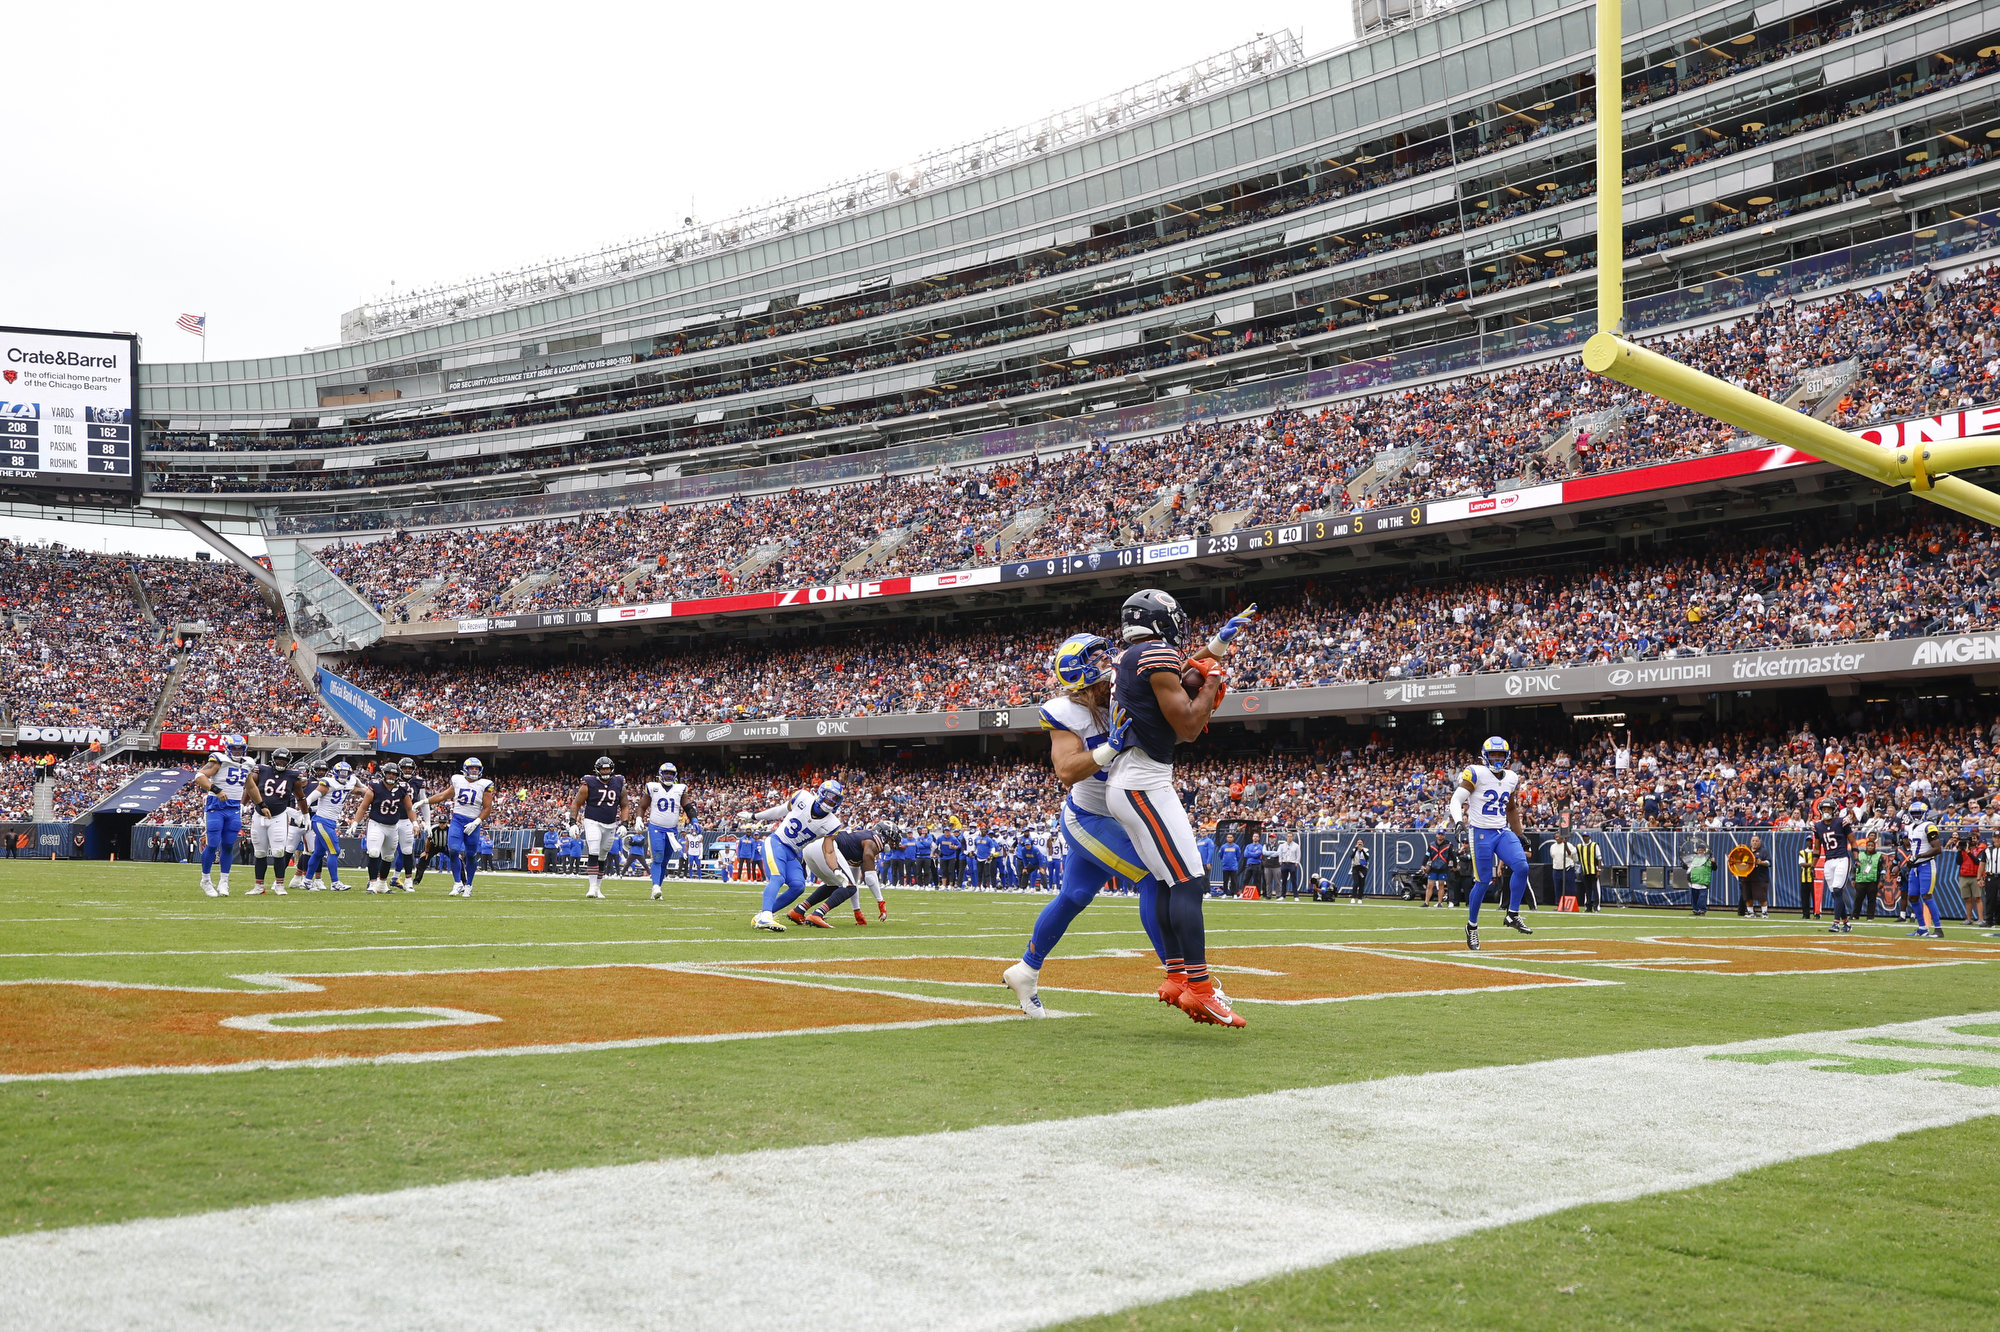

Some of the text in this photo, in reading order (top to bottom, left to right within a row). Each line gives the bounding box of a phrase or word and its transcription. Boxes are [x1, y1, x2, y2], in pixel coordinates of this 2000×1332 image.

[7, 348, 117, 369] Crate&Barrel
[559, 363, 586, 373] LOCATION
[24, 371, 122, 384] the official home partner
[34, 380, 47, 388] the
[48, 380, 83, 390] Chicago
[83, 382, 108, 391] Bears
[1808, 381, 1821, 392] 311
[51, 407, 75, 419] YARDS
[7, 422, 27, 433] 208
[53, 424, 73, 435] TOTAL
[100, 427, 117, 438] 162
[9, 439, 26, 449] 120
[50, 441, 77, 452] PASSING
[102, 444, 115, 454] 88
[11, 455, 24, 466] 88
[50, 458, 78, 469] RUSHING
[103, 460, 115, 471] 74
[15, 471, 37, 479] PLAY.
[1470, 500, 1495, 511] Lenovo
[1316, 507, 1421, 539] 3 AND 5 ON THE 9
[1249, 530, 1273, 550] QTR 3
[1283, 529, 1297, 541] 40
[1208, 535, 1238, 554] 2:39
[1117, 550, 1132, 566] 10
[1150, 545, 1189, 559] GEICO
[1047, 561, 1054, 575] 9
[543, 614, 564, 625] 101 YDS
[575, 612, 591, 623] 0 TDs
[495, 620, 517, 629] Pittman
[1912, 636, 2000, 666] AMGEN
[1732, 651, 1864, 680] ticketmaster
[1637, 665, 1711, 683] HYUNDAI
[1524, 675, 1561, 692] PNC
[1401, 683, 1426, 703] Lite
[330, 680, 343, 698] Official
[364, 699, 376, 720] Bears
[389, 717, 408, 743] PNC
[743, 727, 778, 736] UNITED
[828, 721, 849, 733] PNC
[19, 727, 109, 743] DOWN
[570, 732, 595, 741] VIZZY
[629, 731, 665, 742] Advocate
[264, 779, 287, 798] 64
[458, 788, 477, 806] 51
[598, 789, 616, 806] 79
[380, 799, 400, 815] 65
[784, 818, 817, 847] 37
[40, 834, 60, 846] GSH
[1823, 831, 1838, 850] 15
[531, 858, 539, 867] G
[1244, 888, 1255, 898] 20
